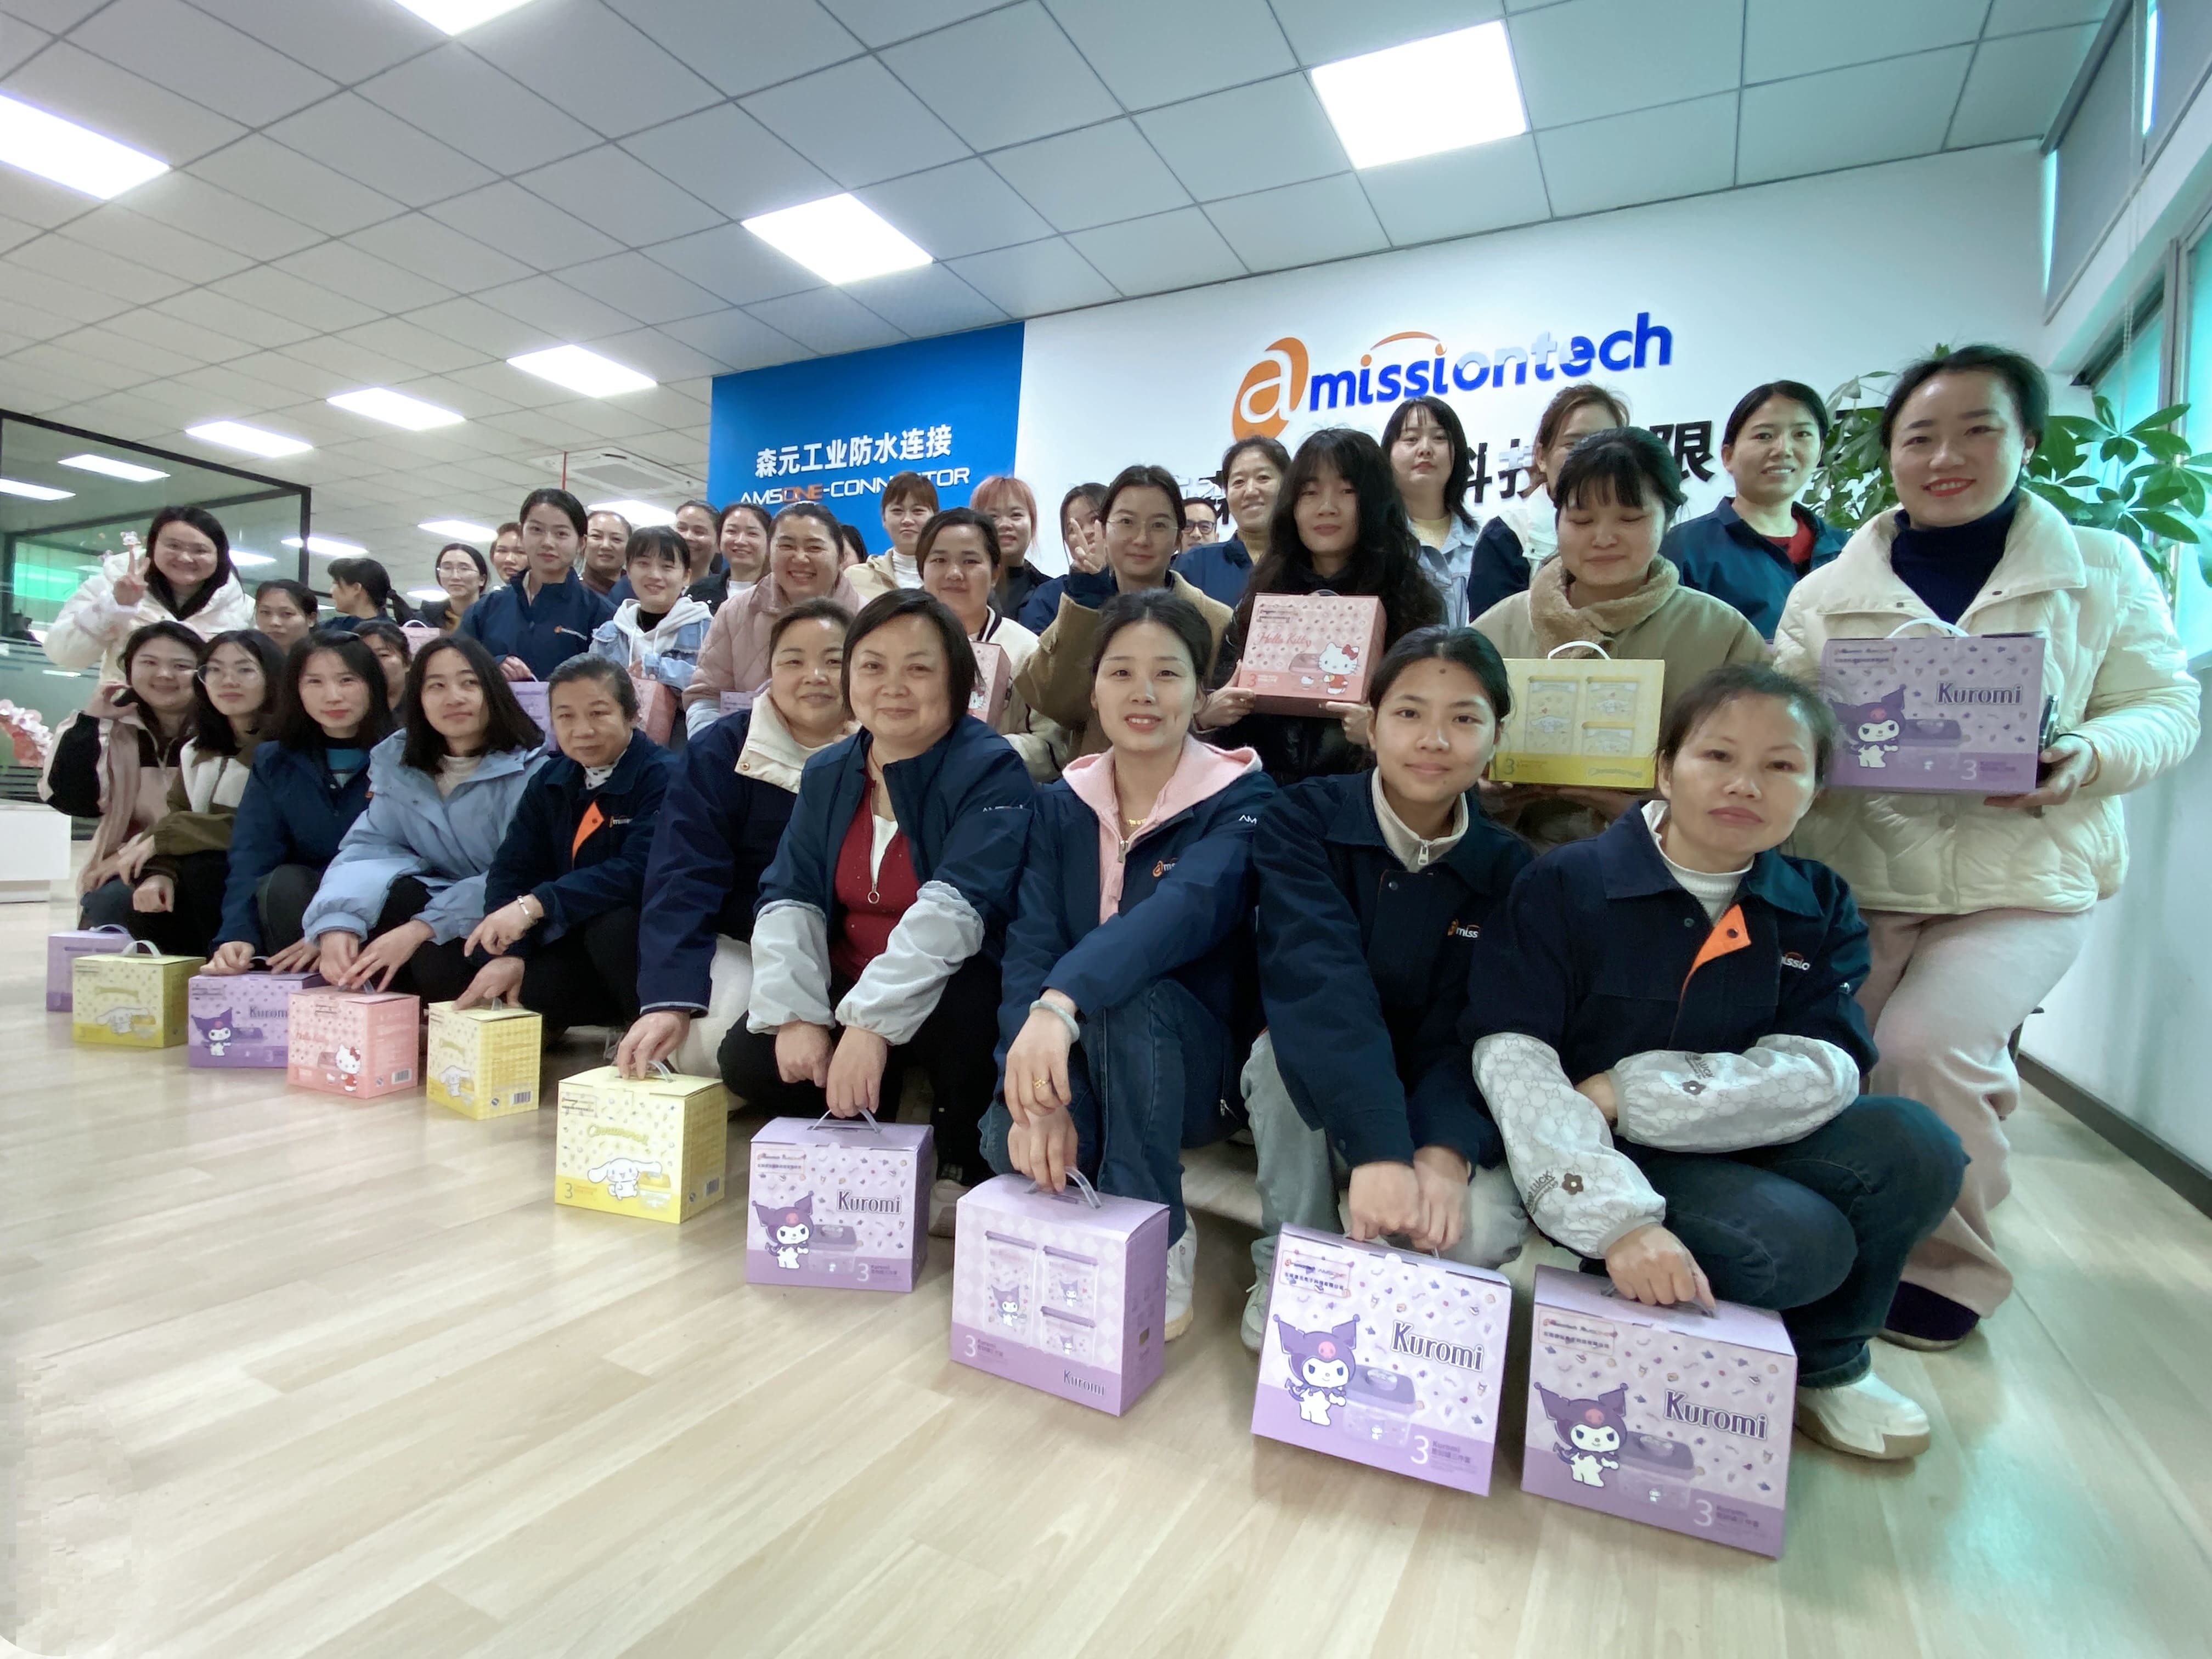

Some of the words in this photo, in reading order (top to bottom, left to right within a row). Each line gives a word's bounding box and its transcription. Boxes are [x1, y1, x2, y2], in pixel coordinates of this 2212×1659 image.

[754, 424, 953, 478] 森元工业防水连接
[740, 467, 970, 505] AMSONE-CONNTOR
[1247, 674, 1256, 687] 3
[1937, 681, 2022, 704] Kuromi
[1960, 759, 1978, 781] 3
[250, 1006, 288, 1018] Kurom
[564, 1182, 573, 1199] 3
[837, 1189, 902, 1214] Kuromi
[856, 1263, 870, 1282] 3
[965, 1335, 976, 1358] 3
[1391, 1319, 1485, 1373] Kuromi
[1063, 1369, 1105, 1396] Kuromi
[1663, 1389, 1769, 1441] Kuromi
[1410, 1435, 1429, 1465] 3
[1693, 1499, 1712, 1527] 3
